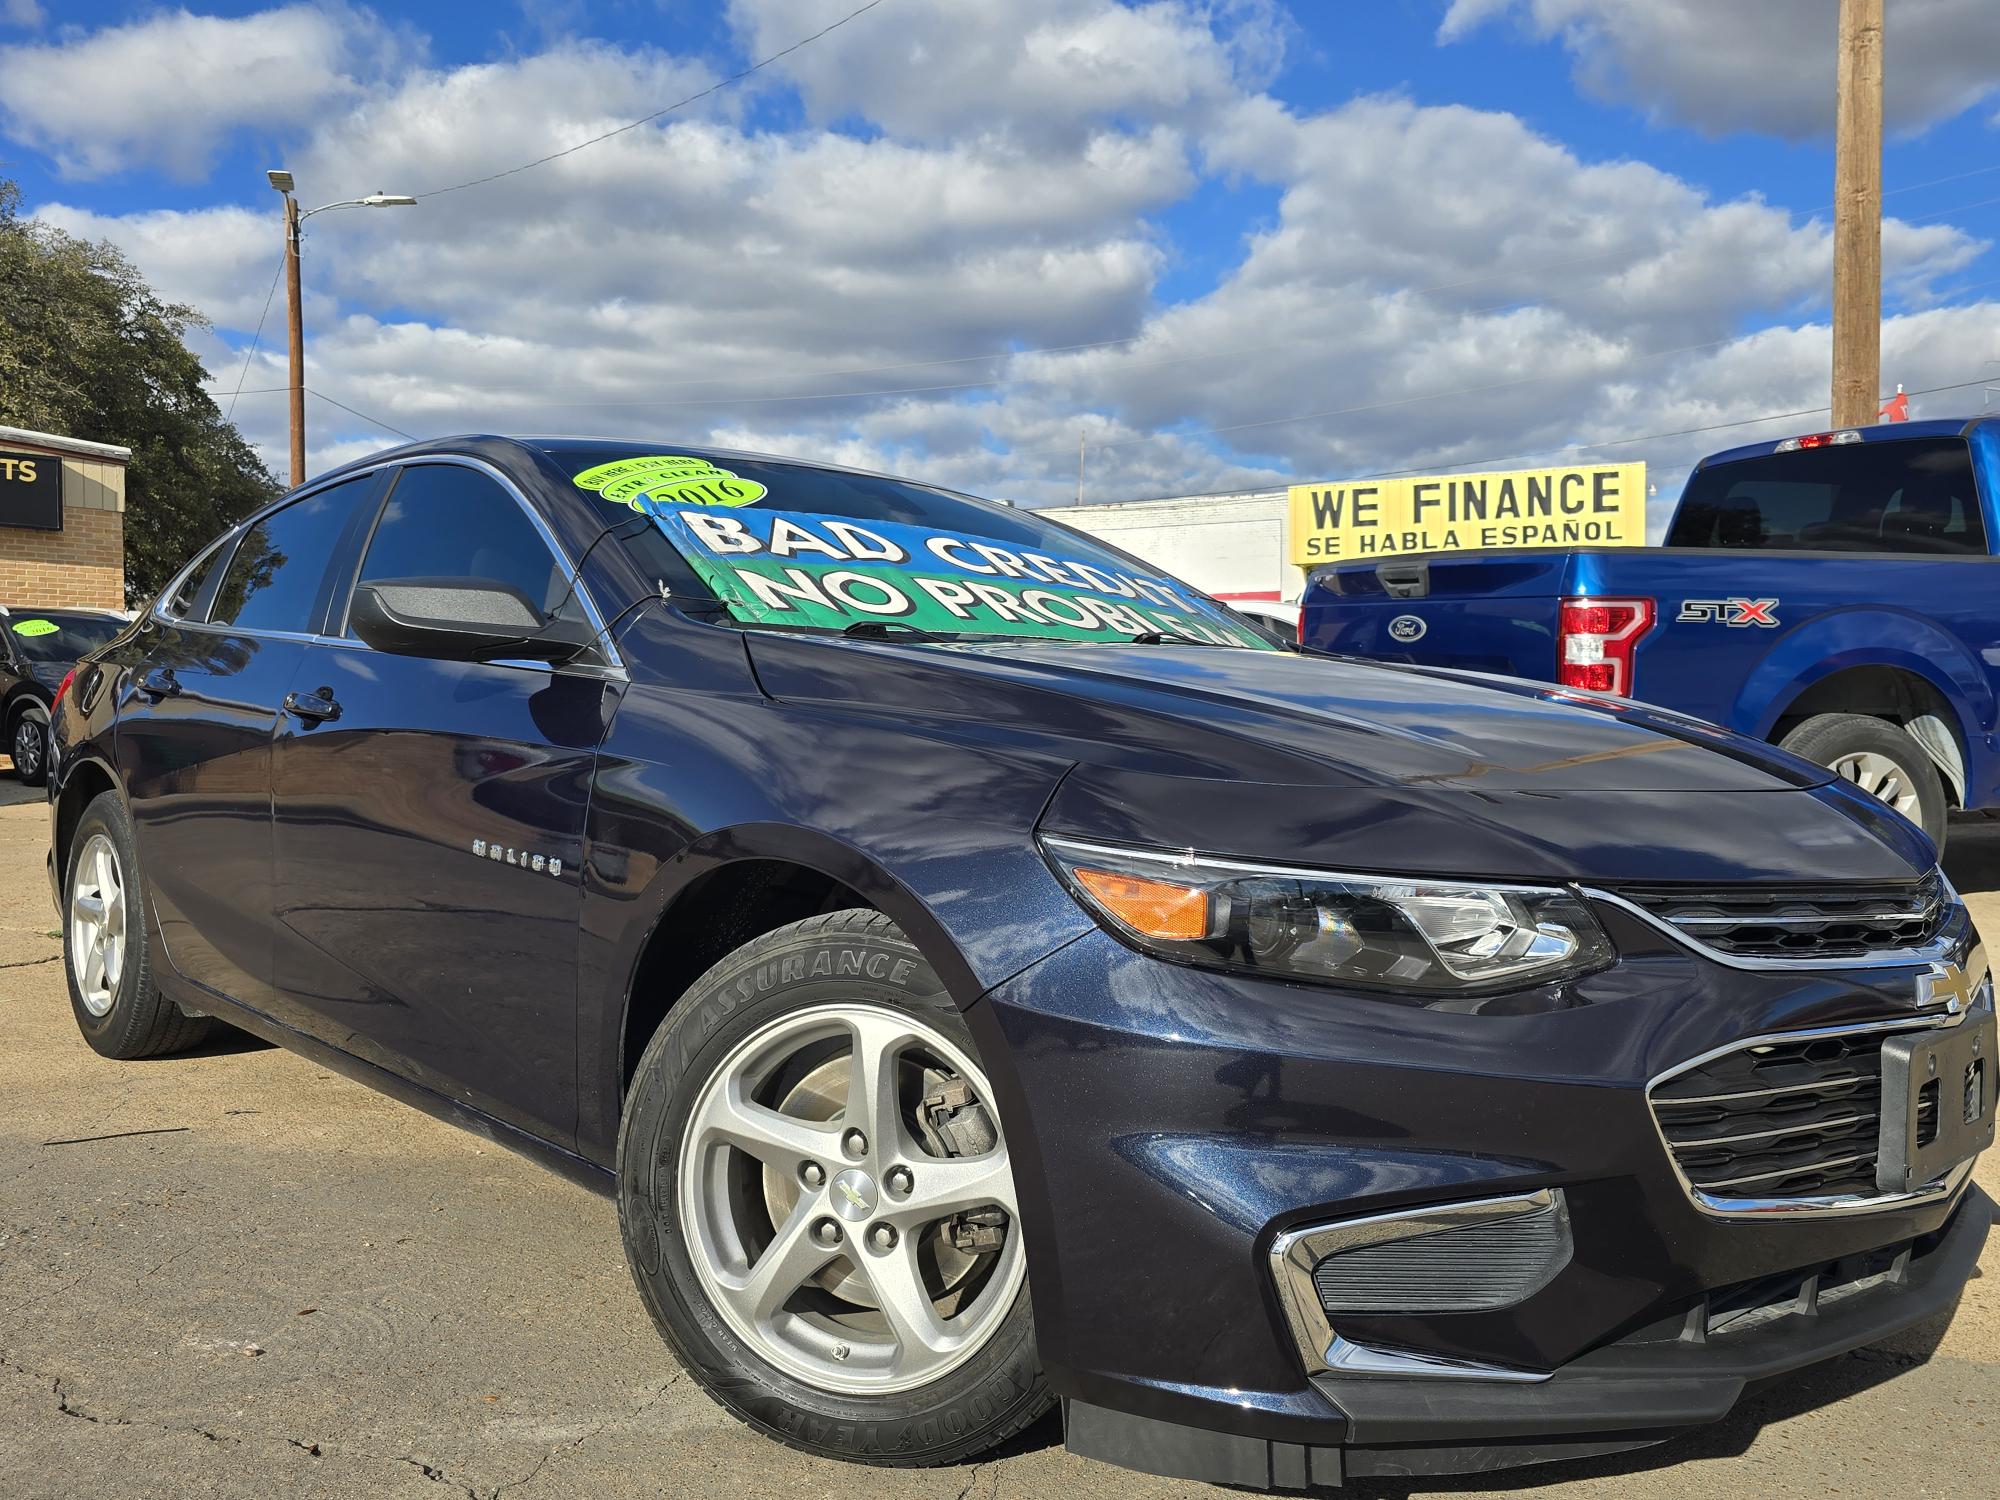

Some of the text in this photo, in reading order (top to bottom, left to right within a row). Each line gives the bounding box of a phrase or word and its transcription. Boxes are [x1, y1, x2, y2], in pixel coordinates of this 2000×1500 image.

[0, 459, 37, 482] TS
[659, 470, 722, 479] CLEAN
[1311, 471, 1619, 530] WE FINANCE
[1306, 519, 1623, 556] SE HABLA ESPAÑOL
[678, 509, 1199, 615] BAD CREDIT
[734, 567, 915, 616] NO
[1676, 597, 1780, 628] STX
[702, 950, 917, 1036] ASSURANCE
